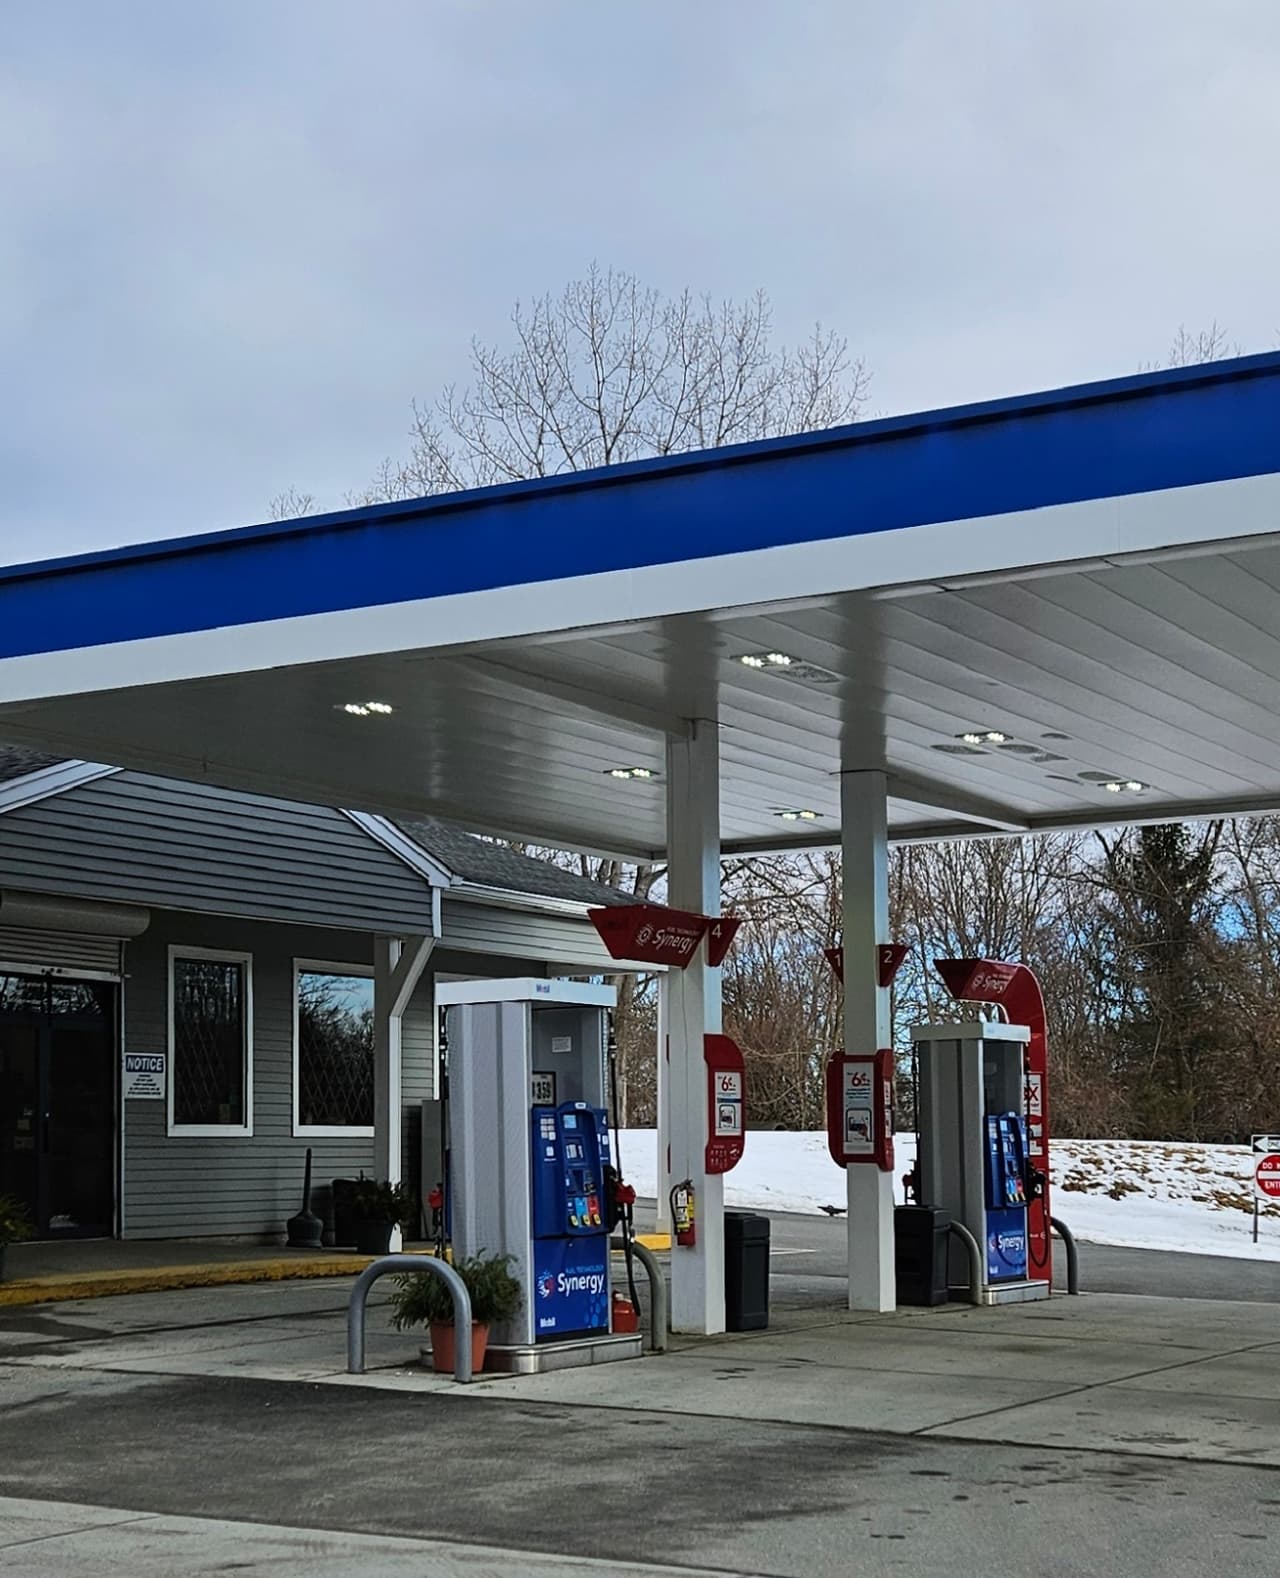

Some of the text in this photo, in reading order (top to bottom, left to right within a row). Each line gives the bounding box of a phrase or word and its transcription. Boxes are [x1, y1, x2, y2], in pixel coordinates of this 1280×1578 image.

[711, 924, 723, 938] 4
[652, 928, 696, 955] Synergy
[834, 954, 841, 967] 1
[883, 951, 893, 963] 2
[127, 1057, 163, 1071] NOTICE
[1262, 1162, 1273, 1170] DO
[557, 1272, 605, 1297] Synergy
